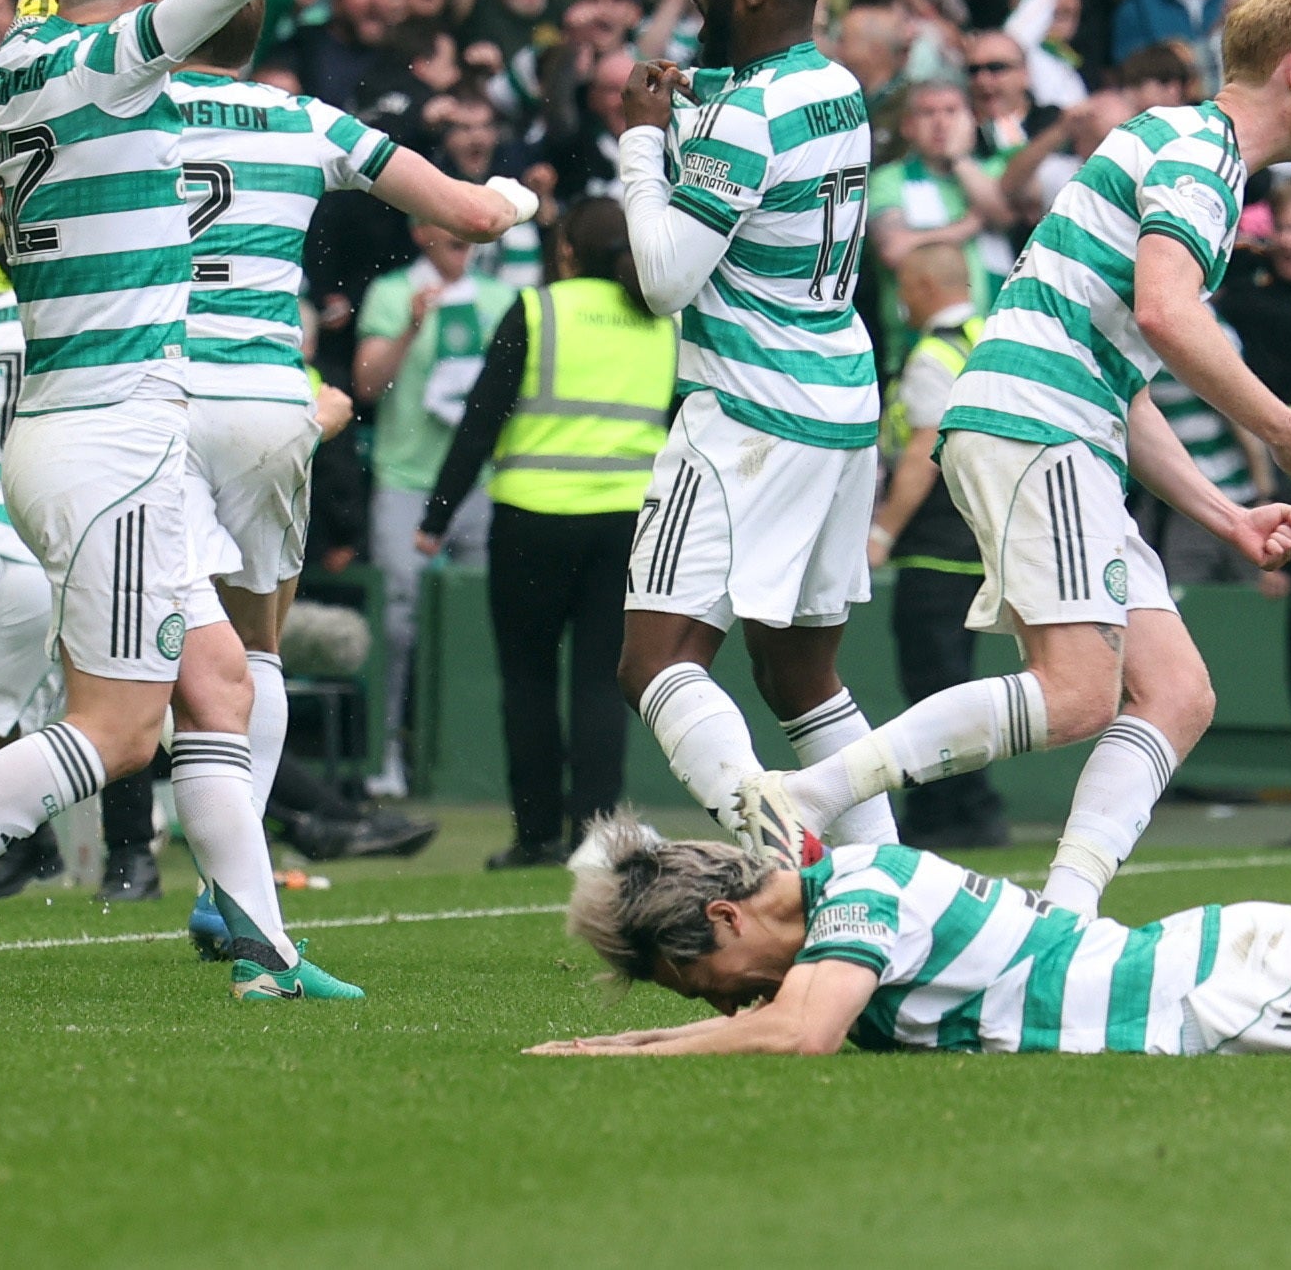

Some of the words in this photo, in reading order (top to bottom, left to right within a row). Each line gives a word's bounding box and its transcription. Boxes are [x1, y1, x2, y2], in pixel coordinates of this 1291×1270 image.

[179, 100, 268, 130] NSTON
[713, 161, 730, 178] FC
[682, 171, 743, 197] OUNDATION
[808, 163, 869, 303] 17
[851, 904, 867, 922] FC
